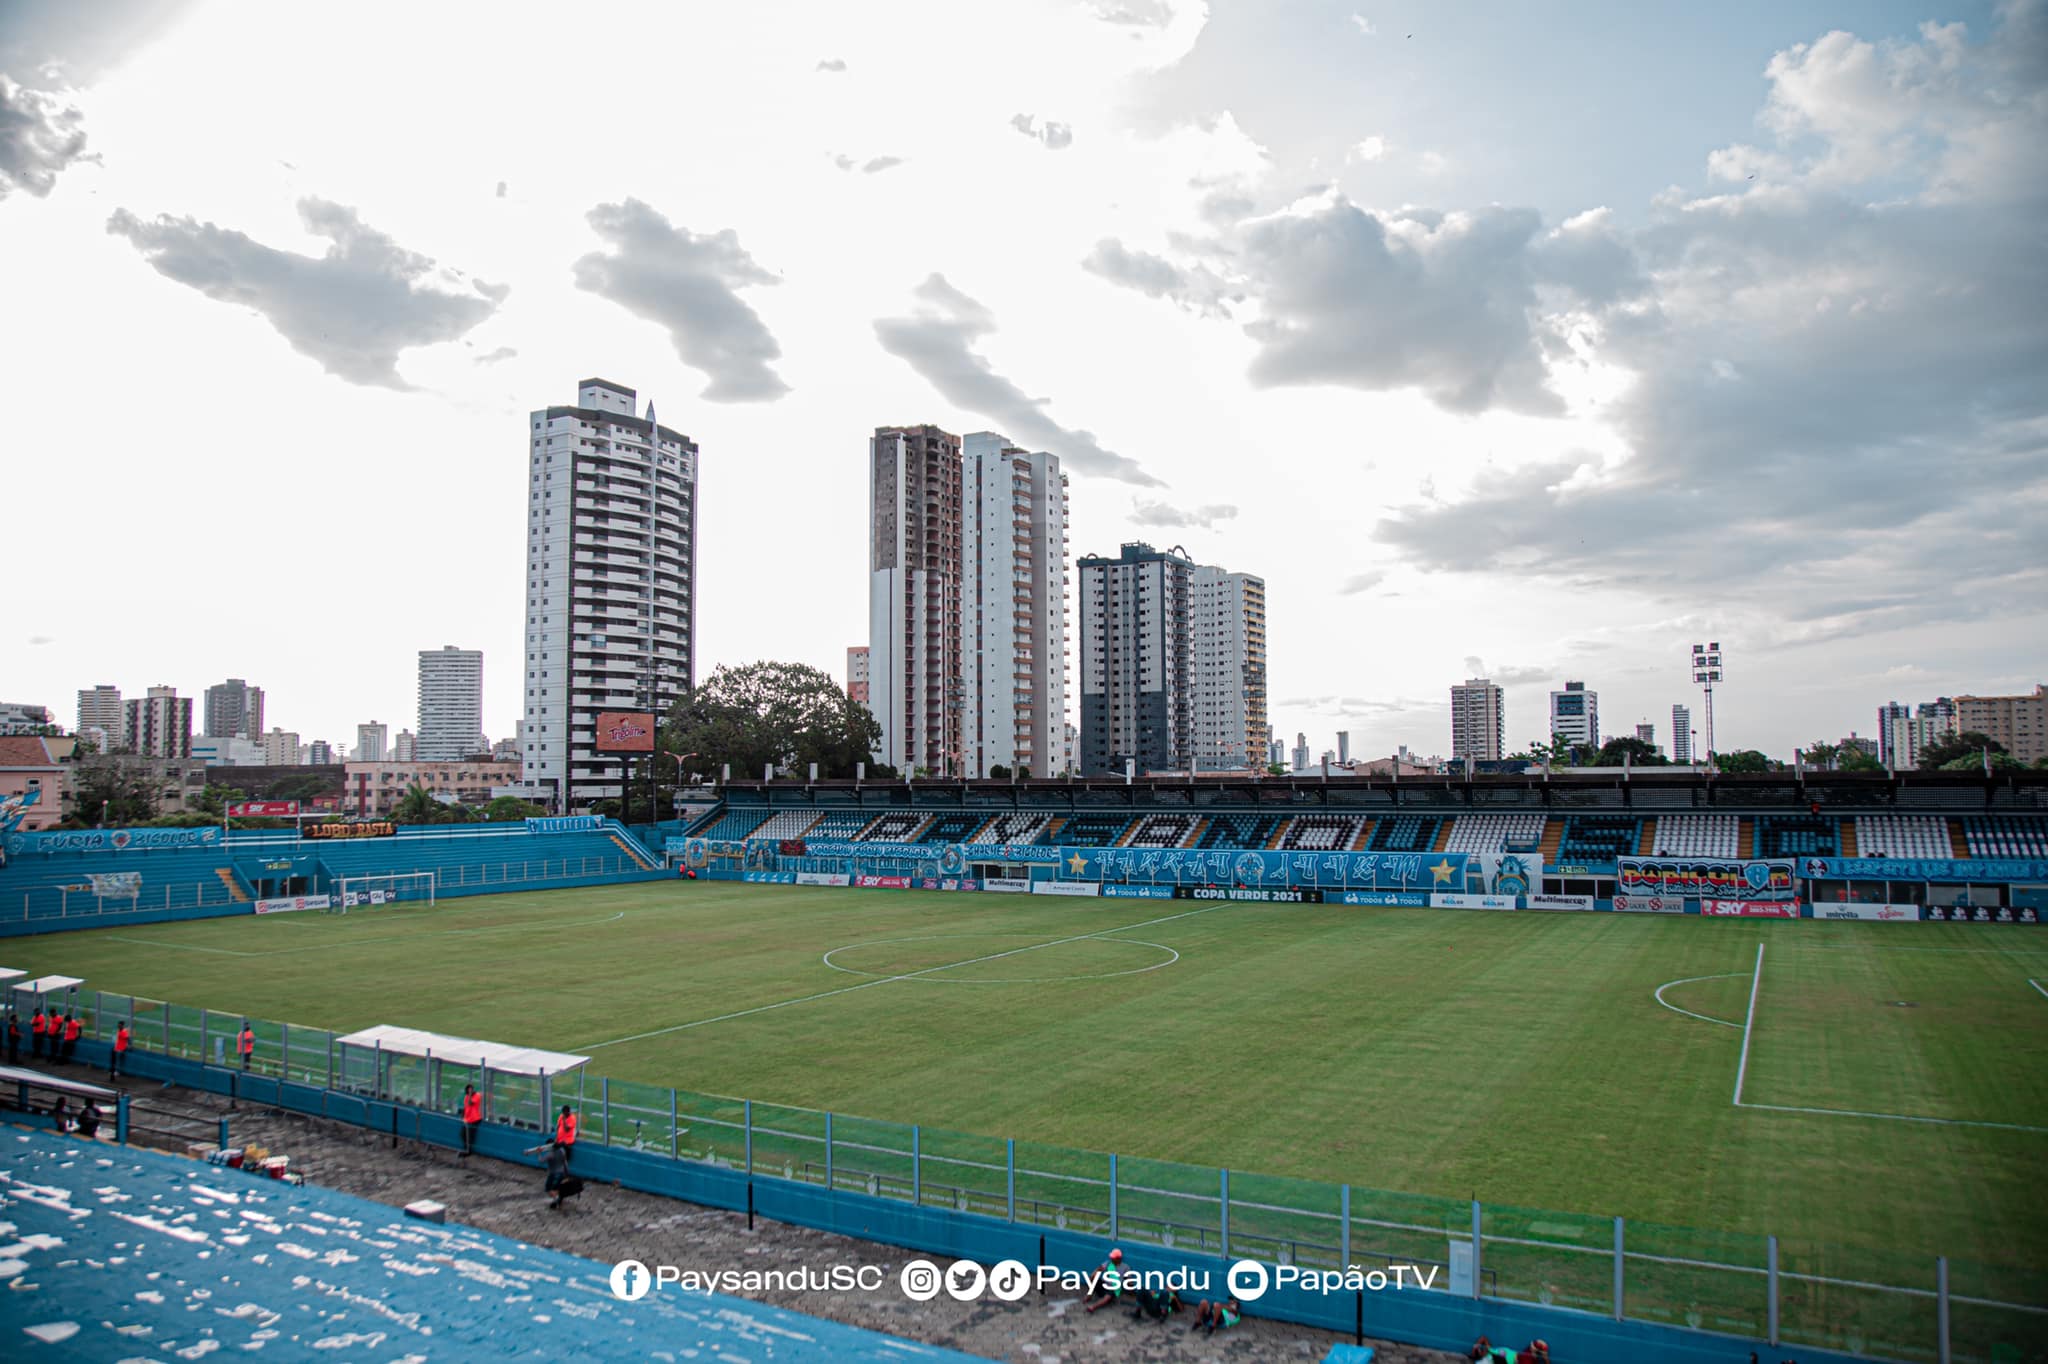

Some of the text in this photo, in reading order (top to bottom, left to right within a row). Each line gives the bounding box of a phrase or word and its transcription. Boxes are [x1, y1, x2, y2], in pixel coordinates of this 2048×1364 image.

[312, 822, 394, 837] LOBO RASTA
[862, 876, 882, 886] SKY
[1193, 888, 1302, 901] COPA VERDE 2021
[1715, 902, 1749, 915] SKY
